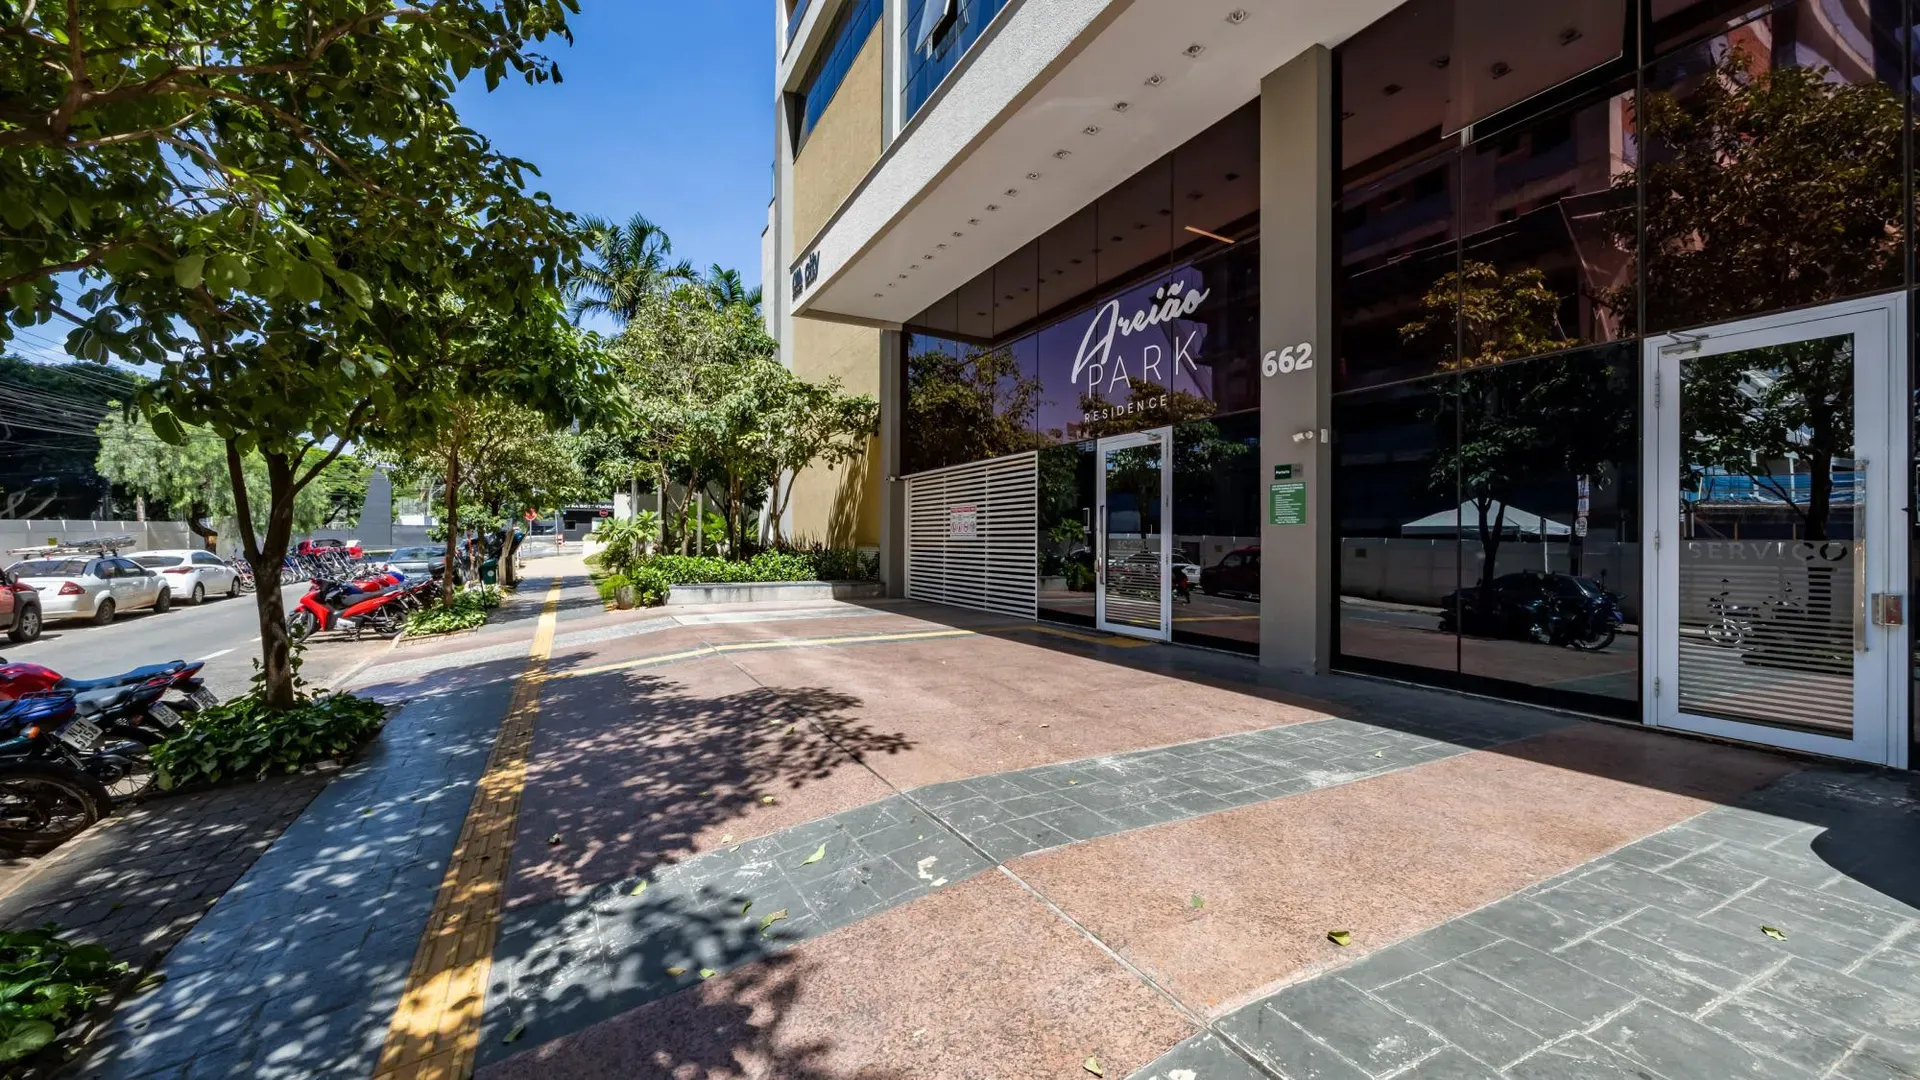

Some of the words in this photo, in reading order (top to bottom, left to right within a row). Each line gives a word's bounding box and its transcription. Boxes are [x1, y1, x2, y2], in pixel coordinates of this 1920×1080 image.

[1071, 280, 1210, 384] Areião
[1088, 330, 1198, 399] PARK
[1262, 342, 1313, 377] 662
[1084, 395, 1168, 423] RESIDENCE
